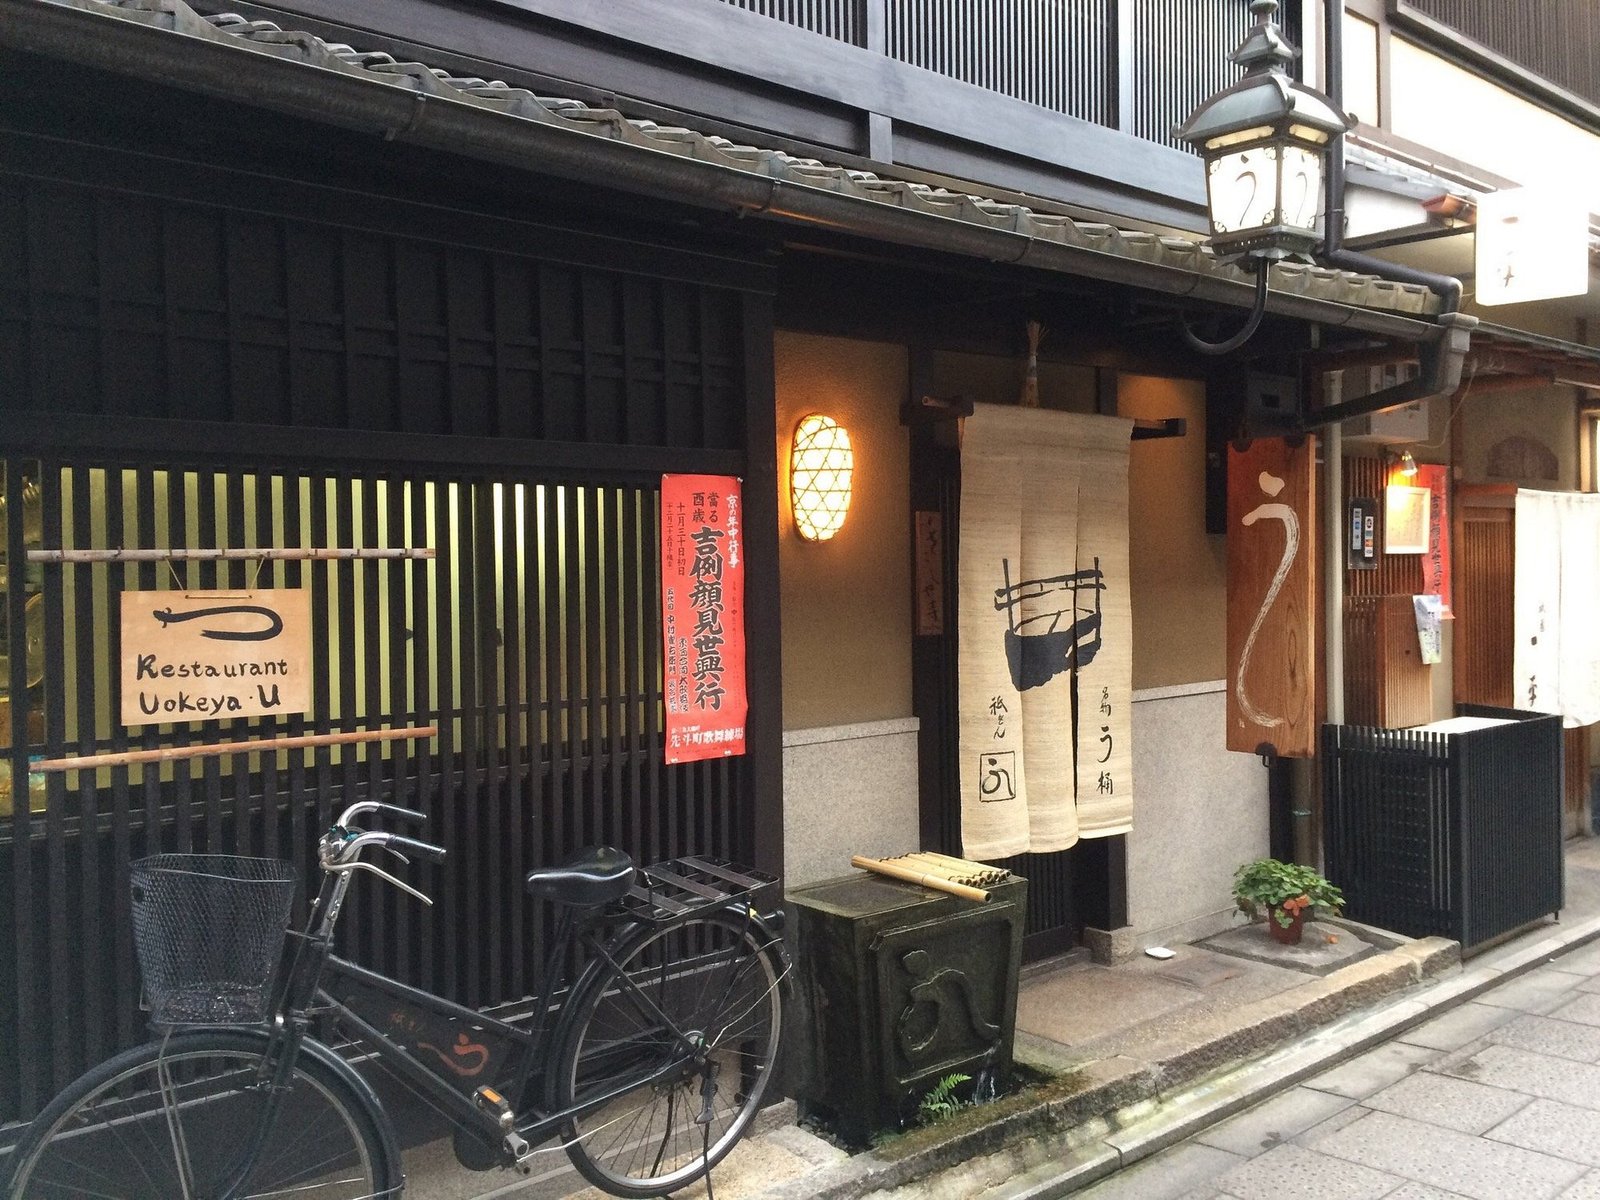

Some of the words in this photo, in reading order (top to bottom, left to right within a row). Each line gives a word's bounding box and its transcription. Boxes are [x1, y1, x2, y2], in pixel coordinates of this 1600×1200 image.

[1236, 154, 1256, 227] う
[677, 502, 686, 576] 十一月三十日初日
[726, 494, 740, 568] 京の年中行事
[688, 526, 726, 711] 吉例顔見世興行
[1236, 471, 1301, 728] う
[136, 653, 288, 681] Restaurant
[139, 690, 242, 716] Uokeya
